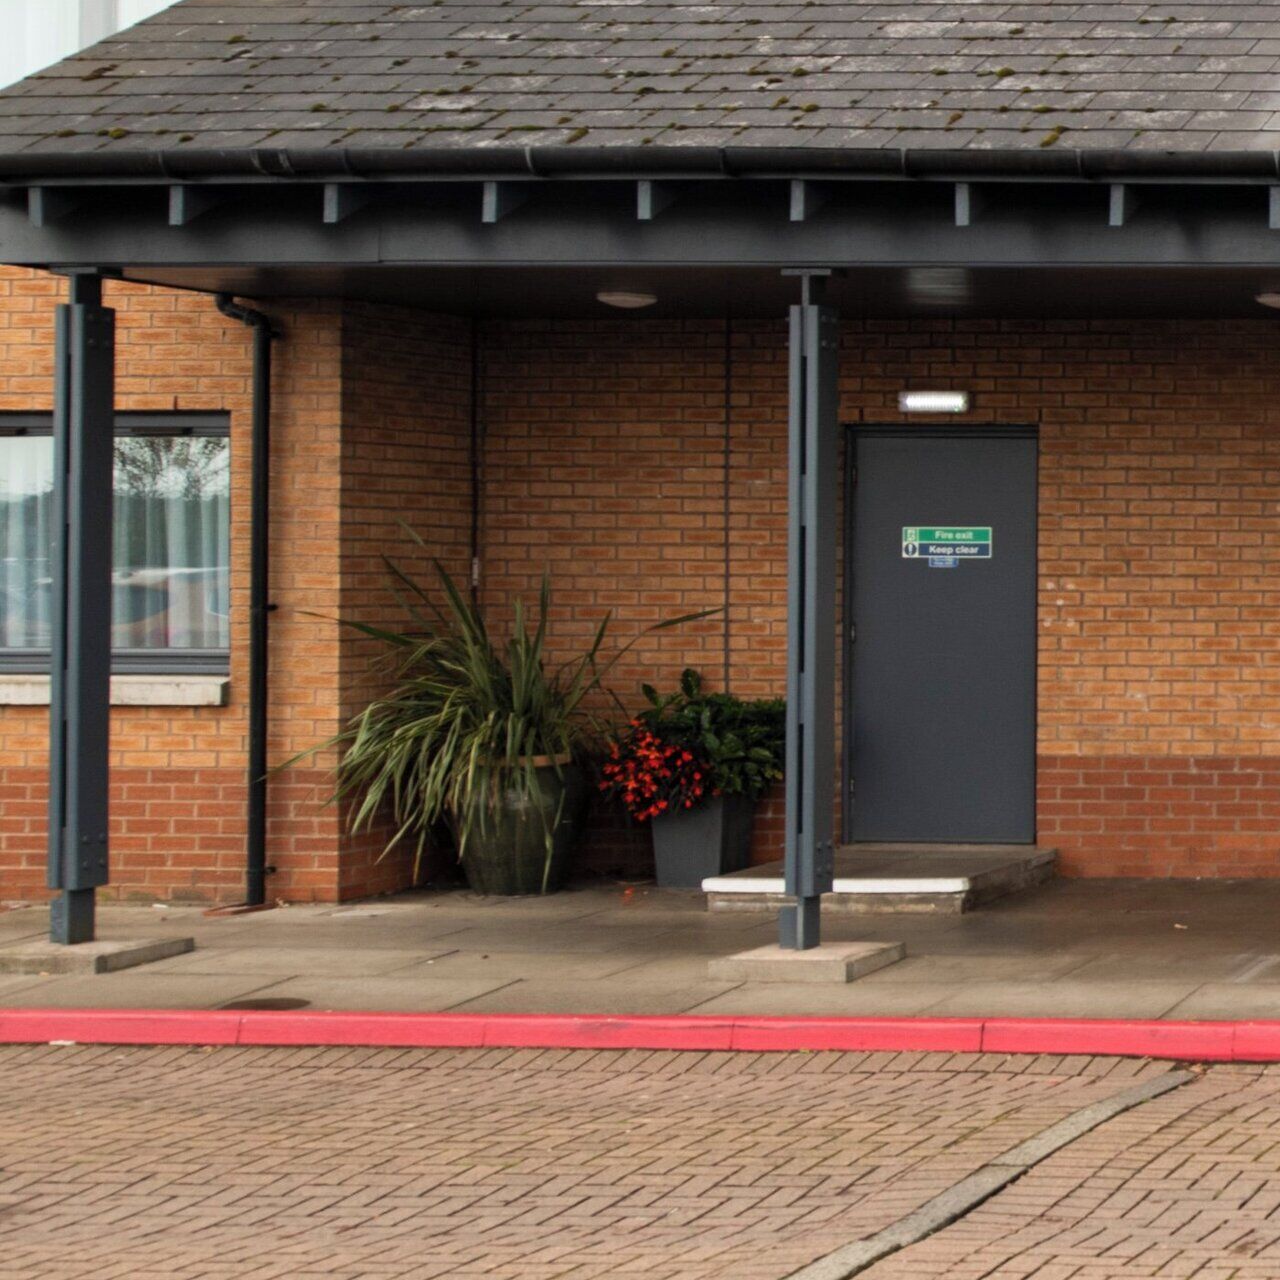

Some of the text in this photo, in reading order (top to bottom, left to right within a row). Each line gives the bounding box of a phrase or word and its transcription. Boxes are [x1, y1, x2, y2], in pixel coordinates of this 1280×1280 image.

[934, 530, 973, 539] Fire exit
[929, 545, 979, 555] Keep clear
